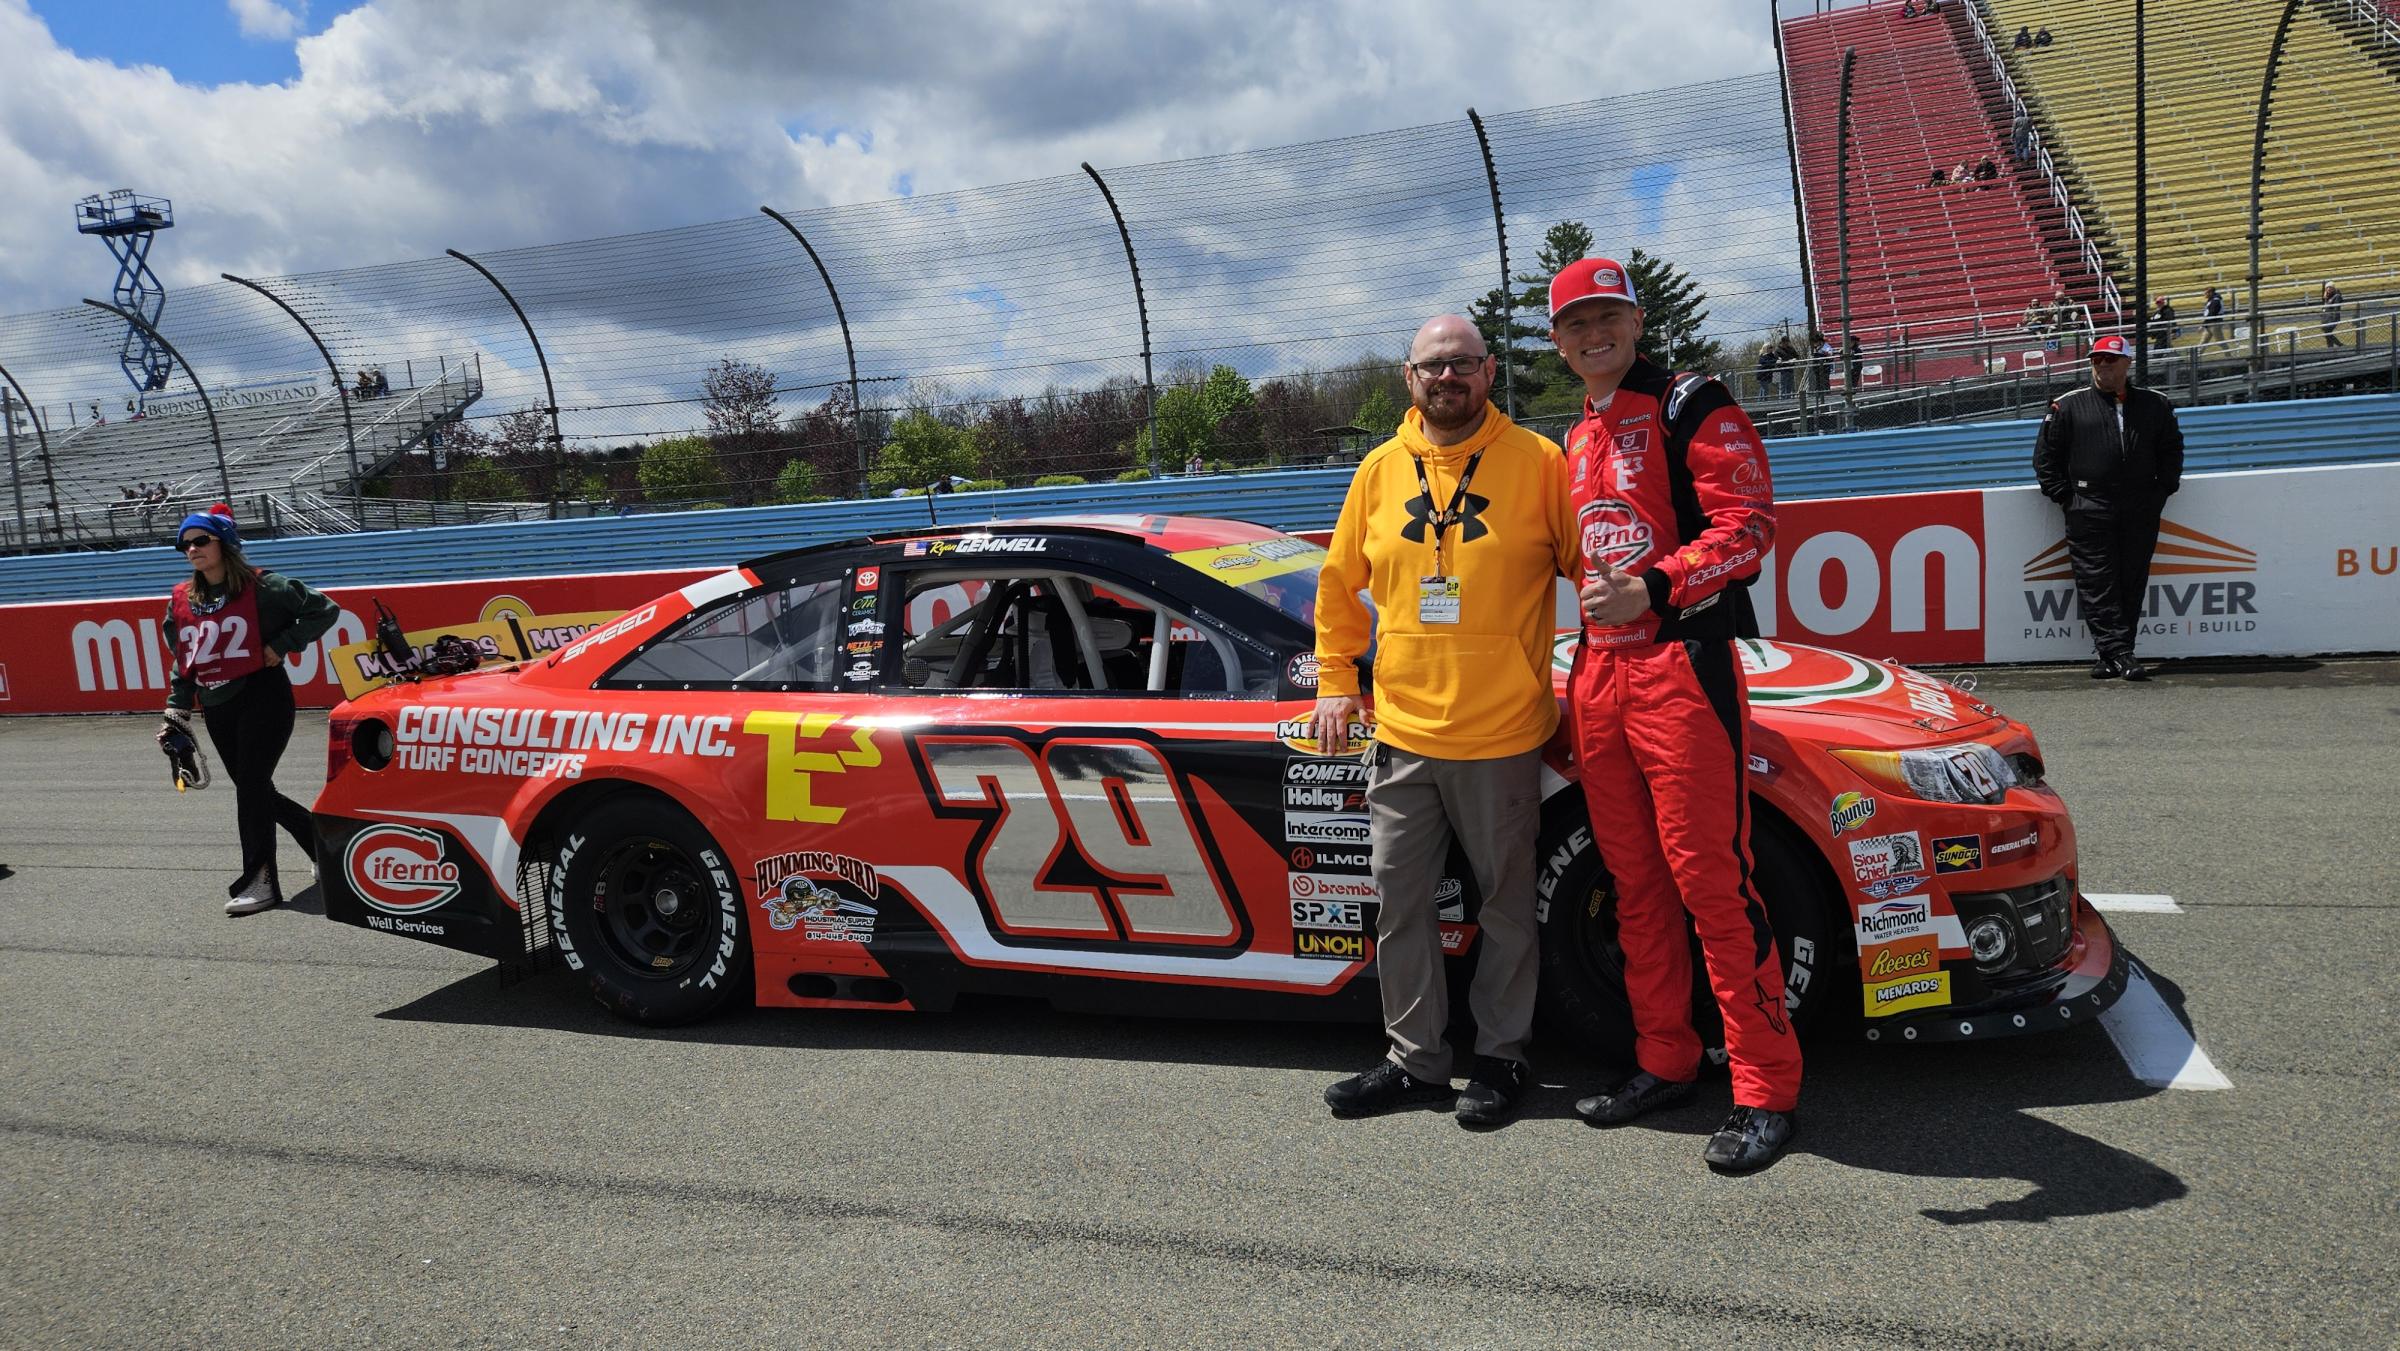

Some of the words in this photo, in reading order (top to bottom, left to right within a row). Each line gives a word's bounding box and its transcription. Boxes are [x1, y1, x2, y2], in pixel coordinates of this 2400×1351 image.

[148, 399, 206, 416] BODINE
[211, 386, 318, 407] GRANDSTAND
[929, 540, 957, 557] Ryan
[955, 538, 1047, 553] GEMMELL
[562, 604, 657, 663] SPEED
[1605, 629, 1648, 644] Gemmell
[2024, 627, 2071, 639] PLAN
[2139, 623, 2178, 635] AGE
[2199, 620, 2257, 633] BUILD
[179, 615, 251, 669] 322
[1294, 654, 1319, 666] NASC
[397, 705, 648, 753] CONSULTING
[650, 715, 736, 758] INC.
[397, 745, 458, 773] TURF
[460, 748, 588, 780] CONCEPTS
[1950, 752, 2000, 799] 29
[1288, 787, 1344, 811] Holley
[1830, 798, 1875, 837] Bounty
[916, 733, 1245, 947] 29
[1288, 821, 1370, 841] Intercomp
[1854, 852, 1889, 867] Sioux
[1936, 848, 1979, 863] SUNOCO
[755, 852, 835, 899] HUMMING
[836, 854, 879, 900] BIRD
[1856, 863, 1888, 881] Chief
[551, 833, 586, 971] GENERAL
[367, 916, 393, 930] Well
[395, 919, 445, 935] Services
[700, 849, 737, 990] GENERAL
[805, 915, 846, 925] INDUSTRIAL
[847, 915, 875, 926] SUPPLY
[1861, 904, 1926, 933] Richmond
[1298, 934, 1363, 955] UNOH
[1874, 931, 1892, 940] WATER
[1893, 925, 1920, 936] HEATERS
[1870, 948, 1931, 976] Reese's
[1876, 979, 1939, 1002] MENARDS
